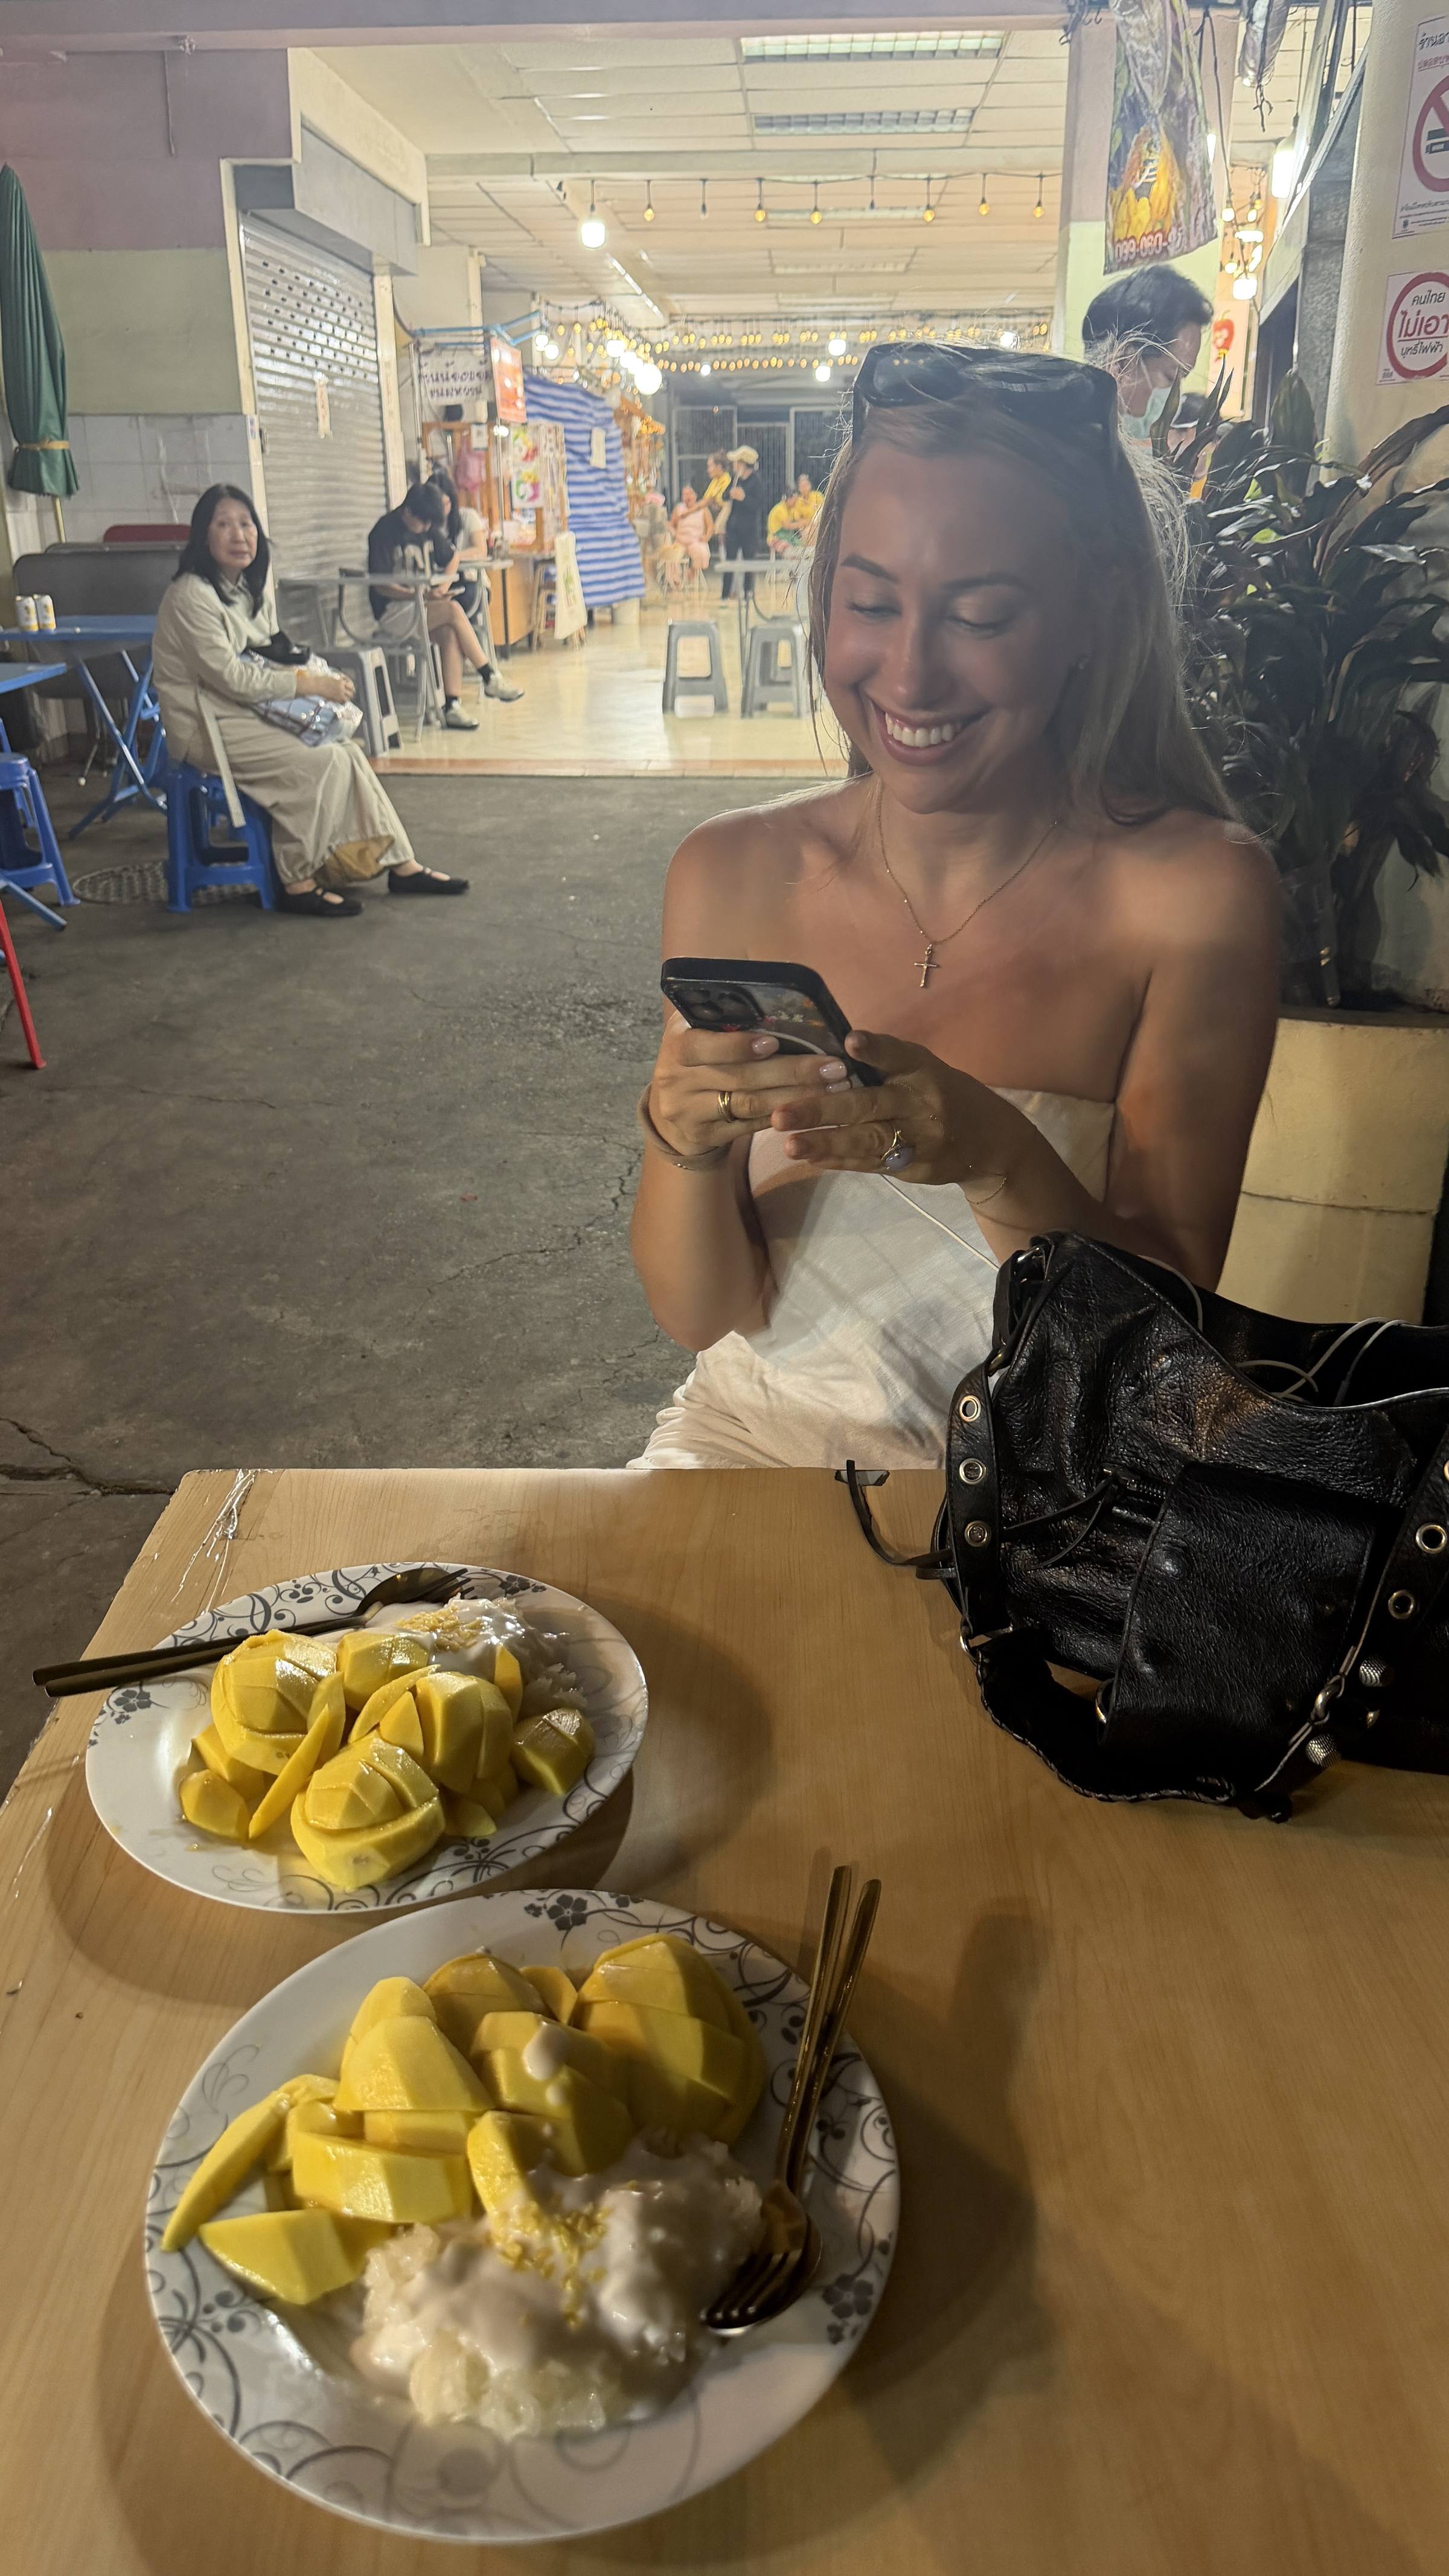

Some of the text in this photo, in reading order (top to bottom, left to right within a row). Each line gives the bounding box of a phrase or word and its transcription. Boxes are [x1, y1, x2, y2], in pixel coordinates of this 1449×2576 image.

[1412, 289, 1446, 306] คนไทย
[1398, 309, 1449, 338] ไม่เอา
[1401, 340, 1444, 359] บุหรี่ไฟฟ้า
